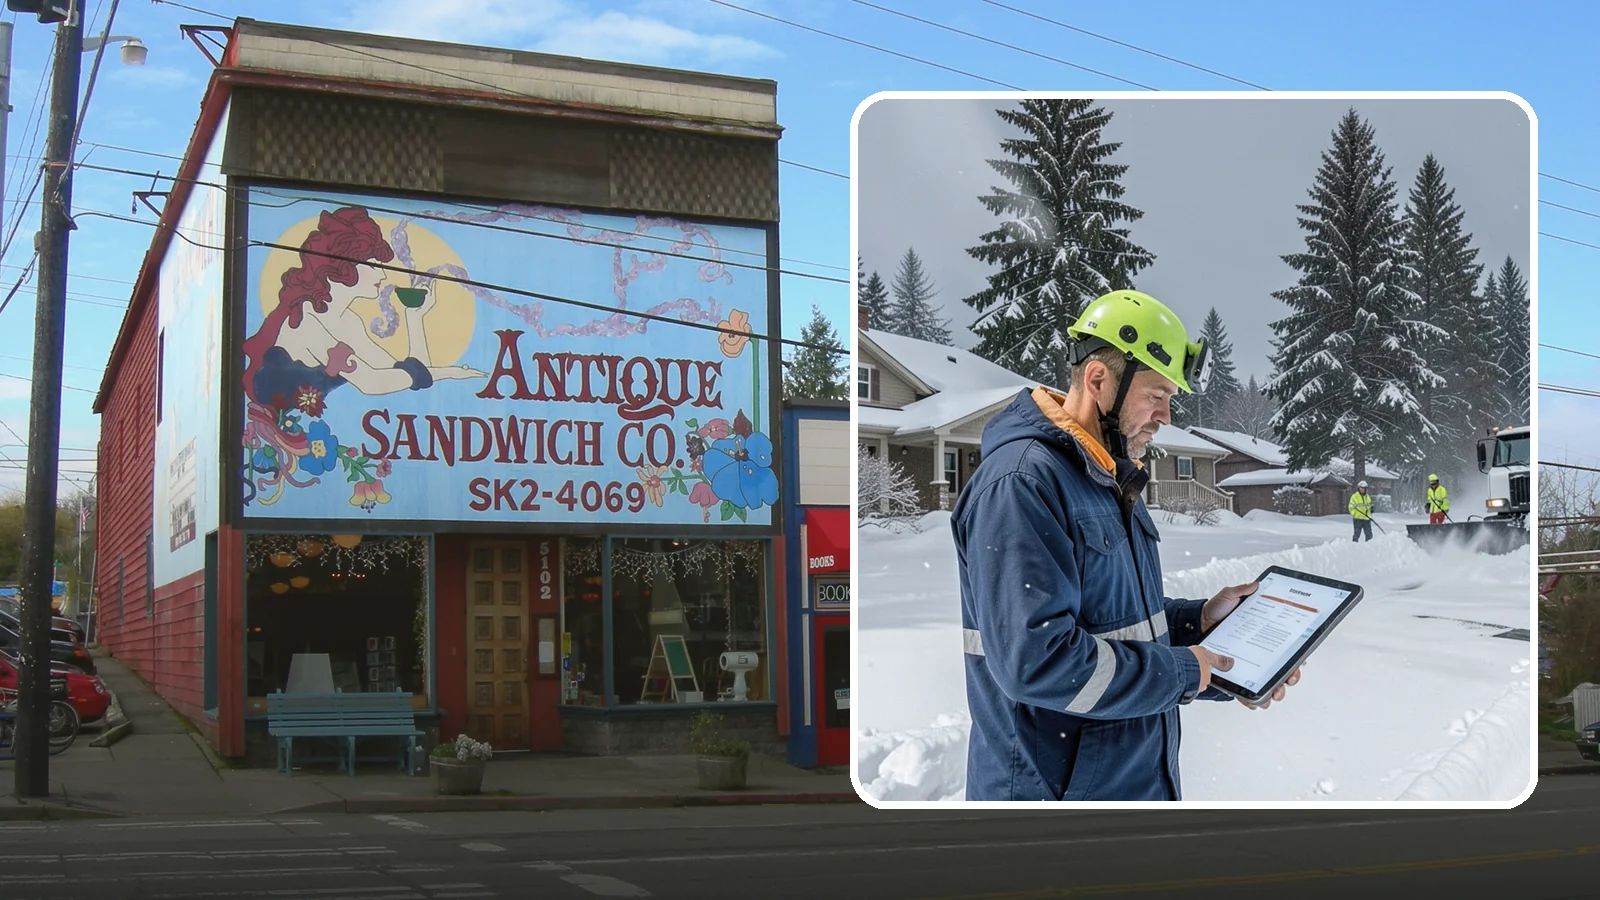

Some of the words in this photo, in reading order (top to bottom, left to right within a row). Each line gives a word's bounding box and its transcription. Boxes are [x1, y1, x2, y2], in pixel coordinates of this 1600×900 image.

[475, 329, 724, 421] ANTIQUE
[361, 408, 605, 468] SANDWICH
[616, 421, 685, 469] CO.
[468, 477, 646, 513] SK2-4069
[540, 542, 551, 599] 5102
[809, 555, 834, 568] BOOKS
